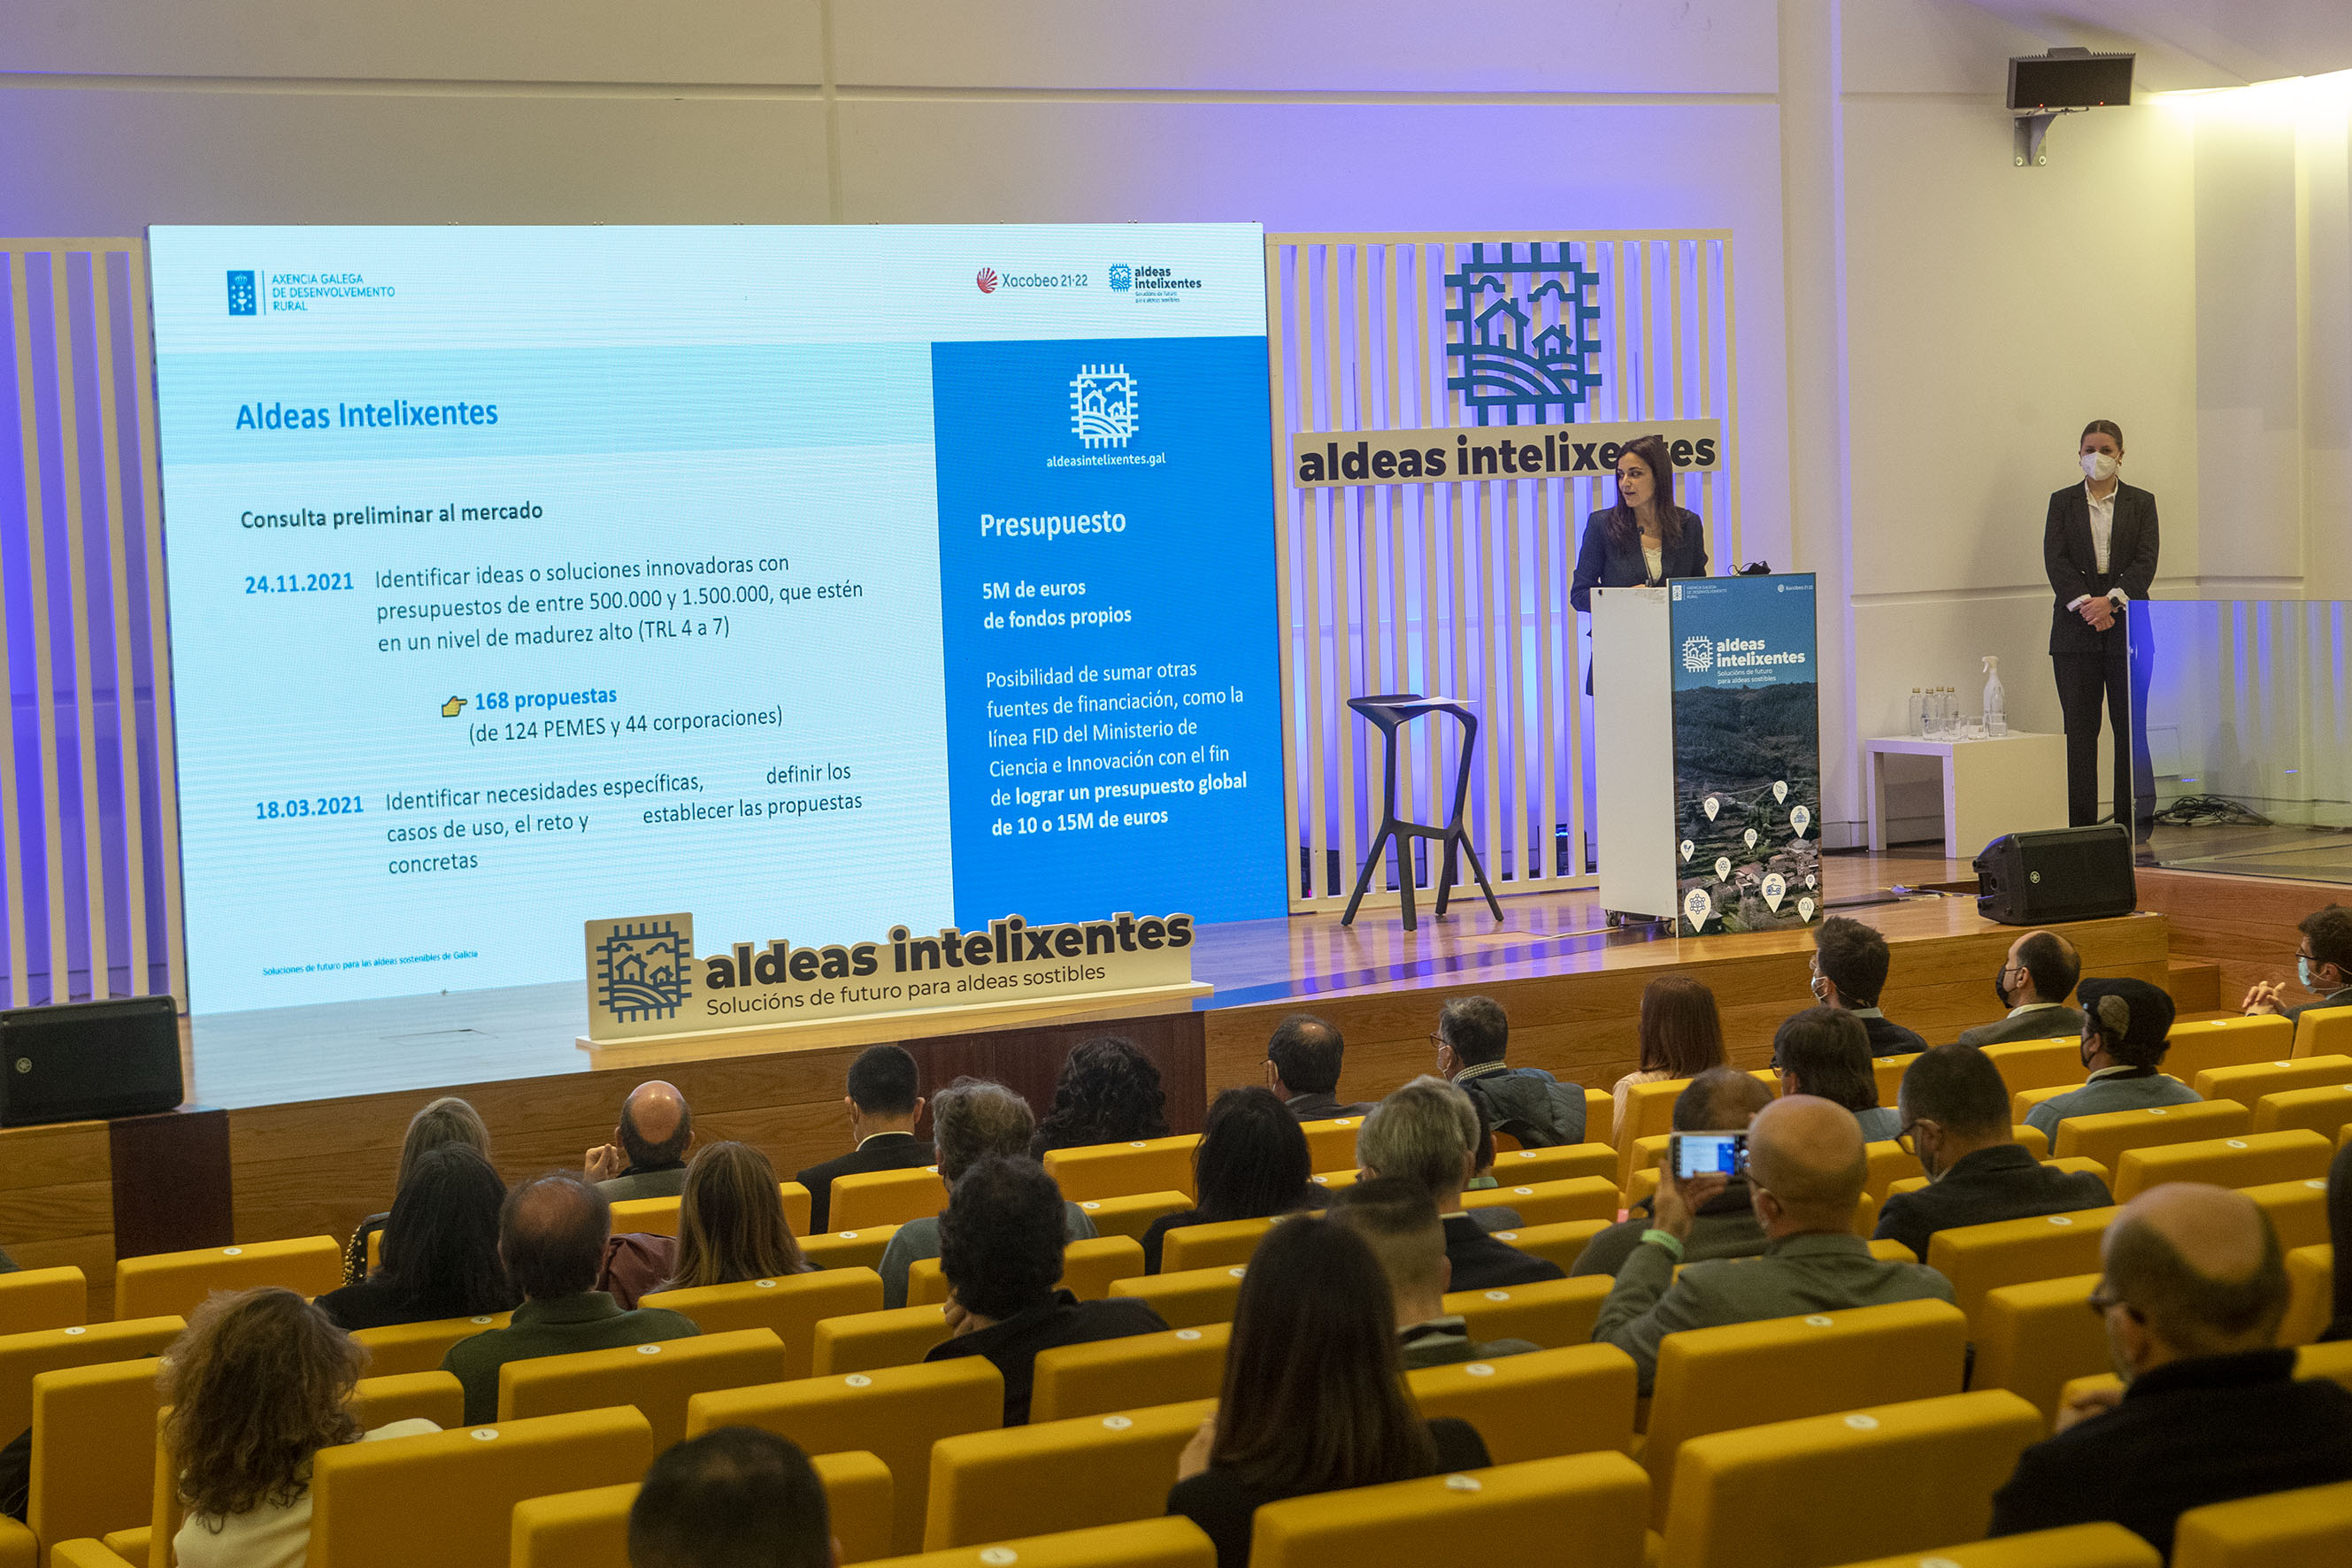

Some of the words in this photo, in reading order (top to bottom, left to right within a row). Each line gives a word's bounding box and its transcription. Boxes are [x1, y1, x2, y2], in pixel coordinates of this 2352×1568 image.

[272, 274, 318, 285] AXENCIA
[320, 273, 365, 284] GALEGA
[1002, 273, 1058, 288] Xacobeo
[1134, 266, 1172, 277] aldeas
[1134, 276, 1202, 289] intelixentes
[273, 288, 288, 298] DE
[289, 287, 396, 298] DESENVOLVEMENTO
[273, 301, 308, 311] RURAL
[236, 402, 330, 430] Aldeas
[340, 399, 498, 427] Intelixentes
[1047, 451, 1166, 468] aldeasintelixentes.gal
[1299, 442, 1447, 482] aldeas
[1457, 430, 1716, 476] intelixees
[242, 509, 327, 528] Consulta
[333, 505, 434, 531] preliminar
[439, 503, 455, 522] al
[461, 501, 543, 521] mercado
[980, 511, 1126, 541] Presupuesto
[245, 573, 355, 594] 24.11.2021
[376, 567, 471, 588] Identificar
[476, 565, 524, 585] ideas
[530, 569, 541, 581] o
[546, 562, 641, 582] soluciones
[647, 556, 753, 576] innovadoras
[758, 557, 789, 572] con
[377, 599, 502, 624] presupuestos
[508, 595, 530, 614] de
[535, 596, 584, 611] entre
[589, 590, 662, 611] 500.000
[667, 592, 677, 611] y
[683, 585, 775, 607] 1.500.000,
[780, 586, 811, 605] que
[817, 580, 864, 599] estén
[982, 581, 1010, 599] 5M
[1015, 580, 1035, 598] de
[1040, 580, 1087, 596] euros
[983, 611, 1004, 629] de
[1009, 609, 1066, 628] fondos
[1070, 606, 1133, 629] propios
[379, 637, 401, 652] en
[408, 635, 431, 650] un
[437, 629, 480, 649] nivel
[487, 628, 509, 647] de
[515, 625, 594, 645] madurez
[599, 622, 633, 641] alto
[639, 619, 677, 642] (TRL
[681, 619, 693, 635] 4
[697, 622, 708, 636] a
[712, 615, 730, 638] 7)
[1717, 638, 1765, 652] aldeas
[1717, 651, 1806, 667] intelixentes
[986, 665, 1074, 688] Posibilidad
[1079, 665, 1098, 683] de
[1103, 666, 1153, 682] sumar
[1157, 663, 1197, 679] otras
[475, 691, 510, 711] 168
[515, 688, 618, 712] propuestas
[987, 700, 1049, 719] fuentes
[1053, 696, 1073, 714] de
[1078, 689, 1178, 714] financiación,
[1182, 690, 1226, 705] como
[1230, 685, 1244, 703] la
[469, 722, 498, 747] (de
[505, 721, 537, 741] 124
[544, 718, 606, 739] PEMES
[611, 720, 619, 738] y
[626, 714, 648, 734] 44
[653, 704, 783, 733] corporaciones)
[988, 729, 1027, 748] línea
[1033, 727, 1058, 744] FID
[1063, 725, 1088, 742] del
[1093, 719, 1173, 742] Ministerio
[1178, 718, 1197, 735] de
[989, 757, 1048, 778] Ciencia
[1052, 759, 1062, 772] e
[1067, 749, 1154, 772] Innovación
[1158, 751, 1187, 766] con
[1191, 746, 1204, 763] el
[1209, 744, 1230, 762] fin
[386, 788, 480, 811] Identificar
[487, 780, 597, 804] necesidades
[603, 773, 704, 798] específicas,
[766, 764, 822, 785] definir
[827, 762, 851, 781] los
[991, 788, 1011, 806] de
[1016, 787, 1065, 807] lograr
[1069, 785, 1090, 800] un
[1095, 778, 1195, 803] presupuesto
[1198, 771, 1247, 795] global
[256, 796, 365, 820] 18.03.2021
[388, 824, 437, 842] casos
[443, 819, 465, 839] de
[472, 821, 509, 837] uso,
[515, 814, 531, 834] el
[537, 814, 573, 833] reto
[579, 814, 588, 833] y
[643, 803, 734, 824] establecer
[739, 799, 762, 818] las
[767, 794, 863, 819] propuestas
[992, 819, 1012, 836] de
[1018, 817, 1037, 834] 10
[1041, 818, 1053, 832] o
[1057, 811, 1094, 832] 15M
[1098, 811, 1118, 828] de
[1123, 810, 1169, 826] euros
[388, 852, 479, 874] concretas
[263, 965, 304, 976] Soluciones
[317, 962, 342, 972] futuro
[342, 961, 360, 971] para
[373, 957, 398, 966] aldeas
[399, 953, 441, 965] sostenibles
[442, 952, 452, 961] de
[453, 949, 479, 959] Galicia
[705, 942, 879, 989] aldeas
[893, 917, 1193, 972] intelixentes
[707, 993, 804, 1016] Solucións
[811, 988, 834, 1006] de
[841, 985, 902, 1003] futuro
[909, 980, 950, 1000] para
[957, 973, 1018, 992] aldeas
[1024, 964, 1105, 986] sostibles
